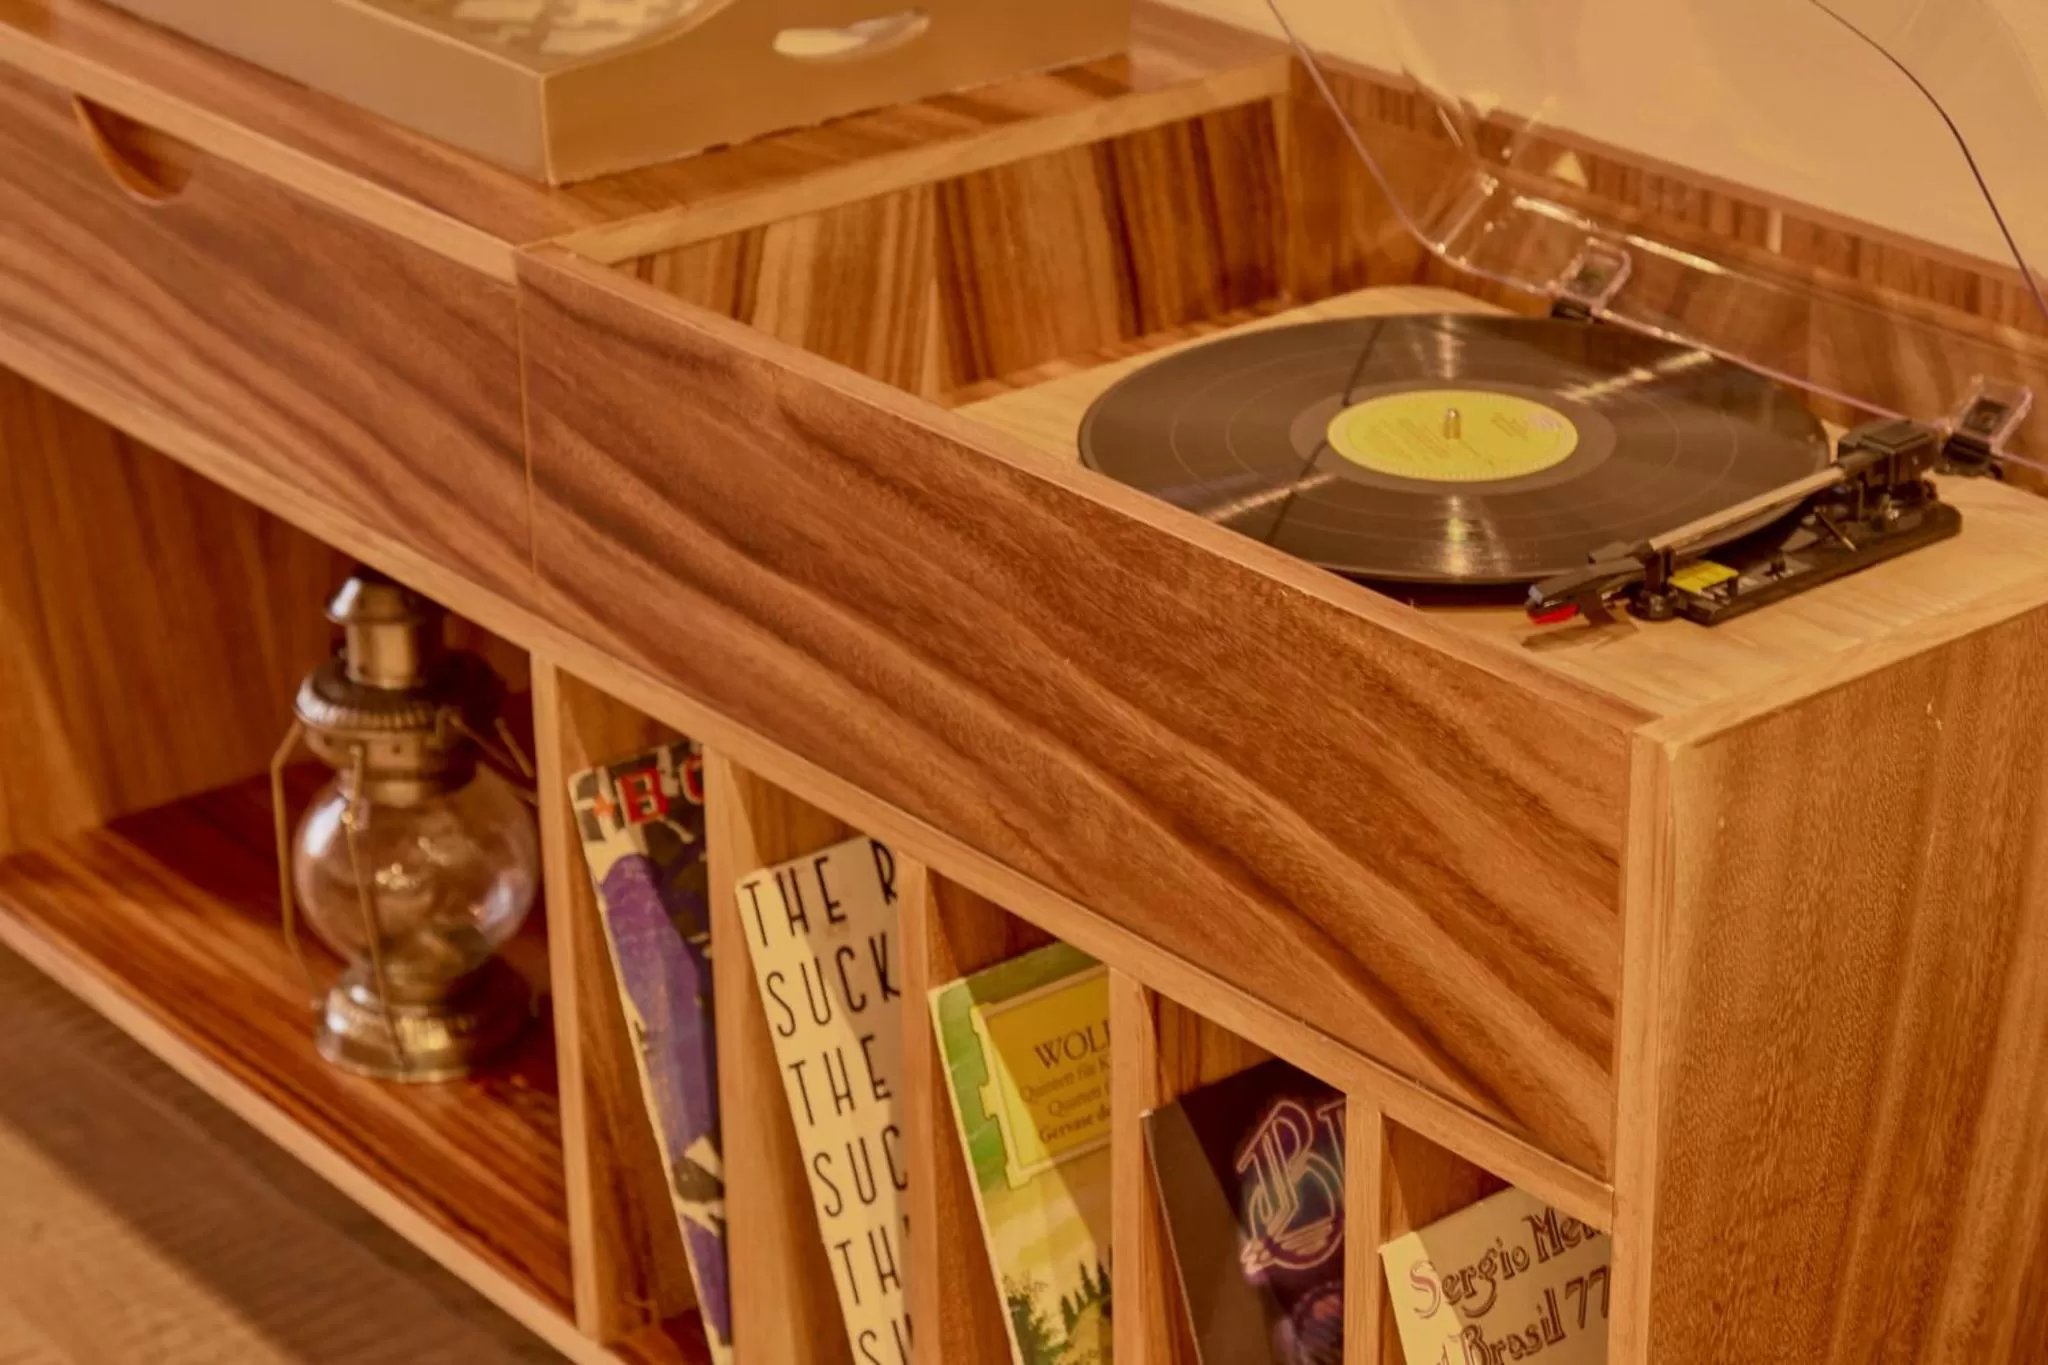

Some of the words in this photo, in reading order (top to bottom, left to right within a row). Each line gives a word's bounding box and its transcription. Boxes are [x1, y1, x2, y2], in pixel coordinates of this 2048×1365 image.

[743, 856, 848, 948] THE
[766, 931, 901, 1038] SUCK
[788, 1033, 892, 1127] THE
[1409, 1232, 1531, 1320] Sergio
[1449, 1287, 1567, 1365] Brasil
